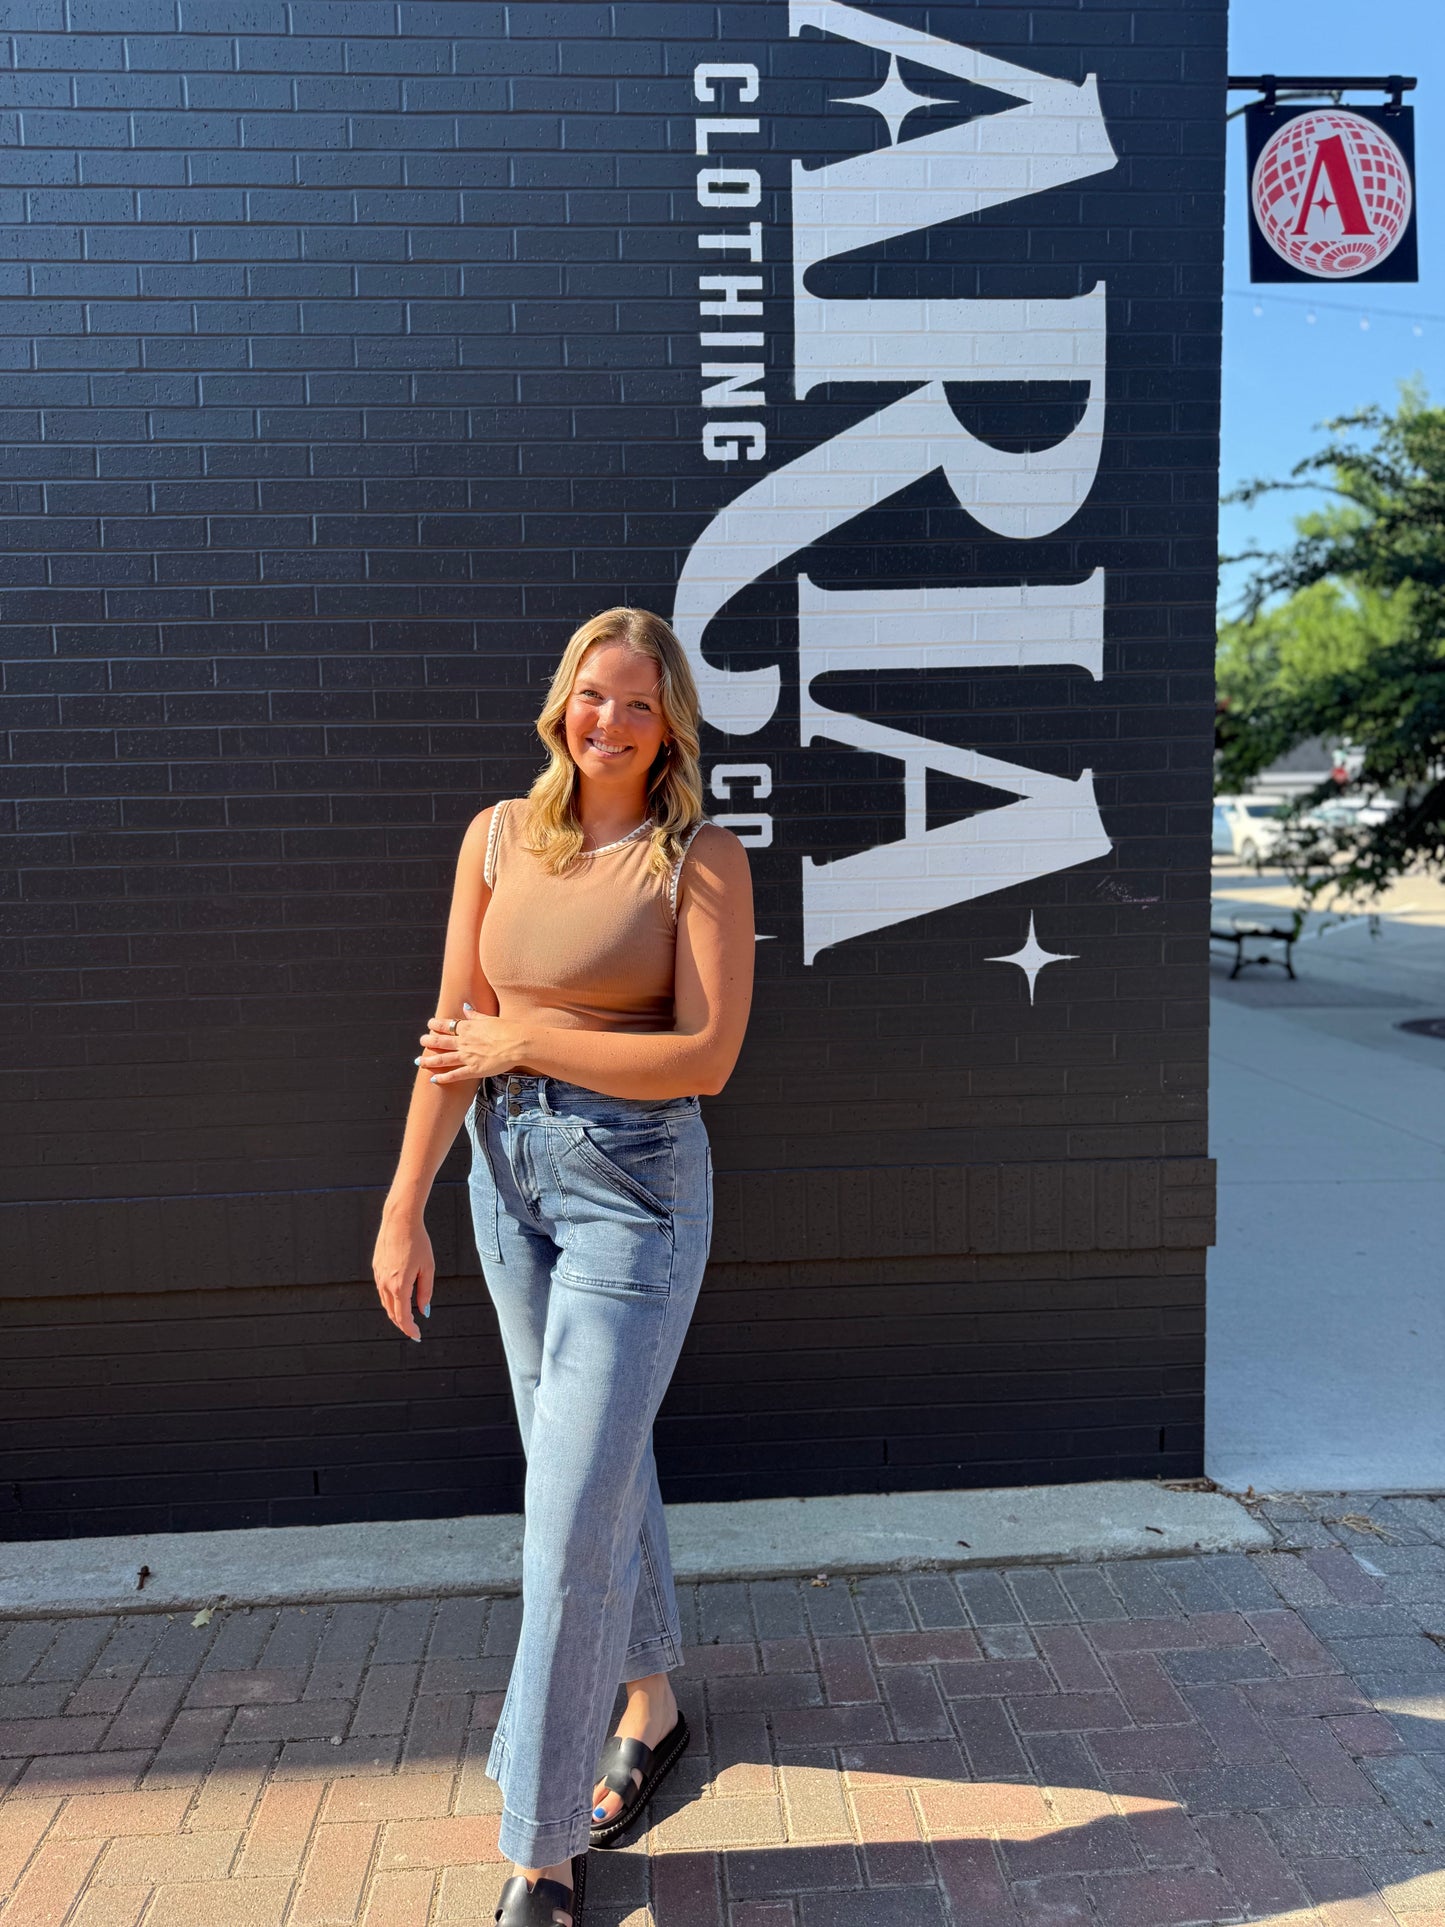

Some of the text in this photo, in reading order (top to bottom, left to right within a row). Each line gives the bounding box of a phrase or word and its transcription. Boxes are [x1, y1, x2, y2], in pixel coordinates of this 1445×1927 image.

[673, 0, 1119, 966] ARIA
[694, 63, 774, 848] CLOTHING CO
[1290, 134, 1375, 235] A
